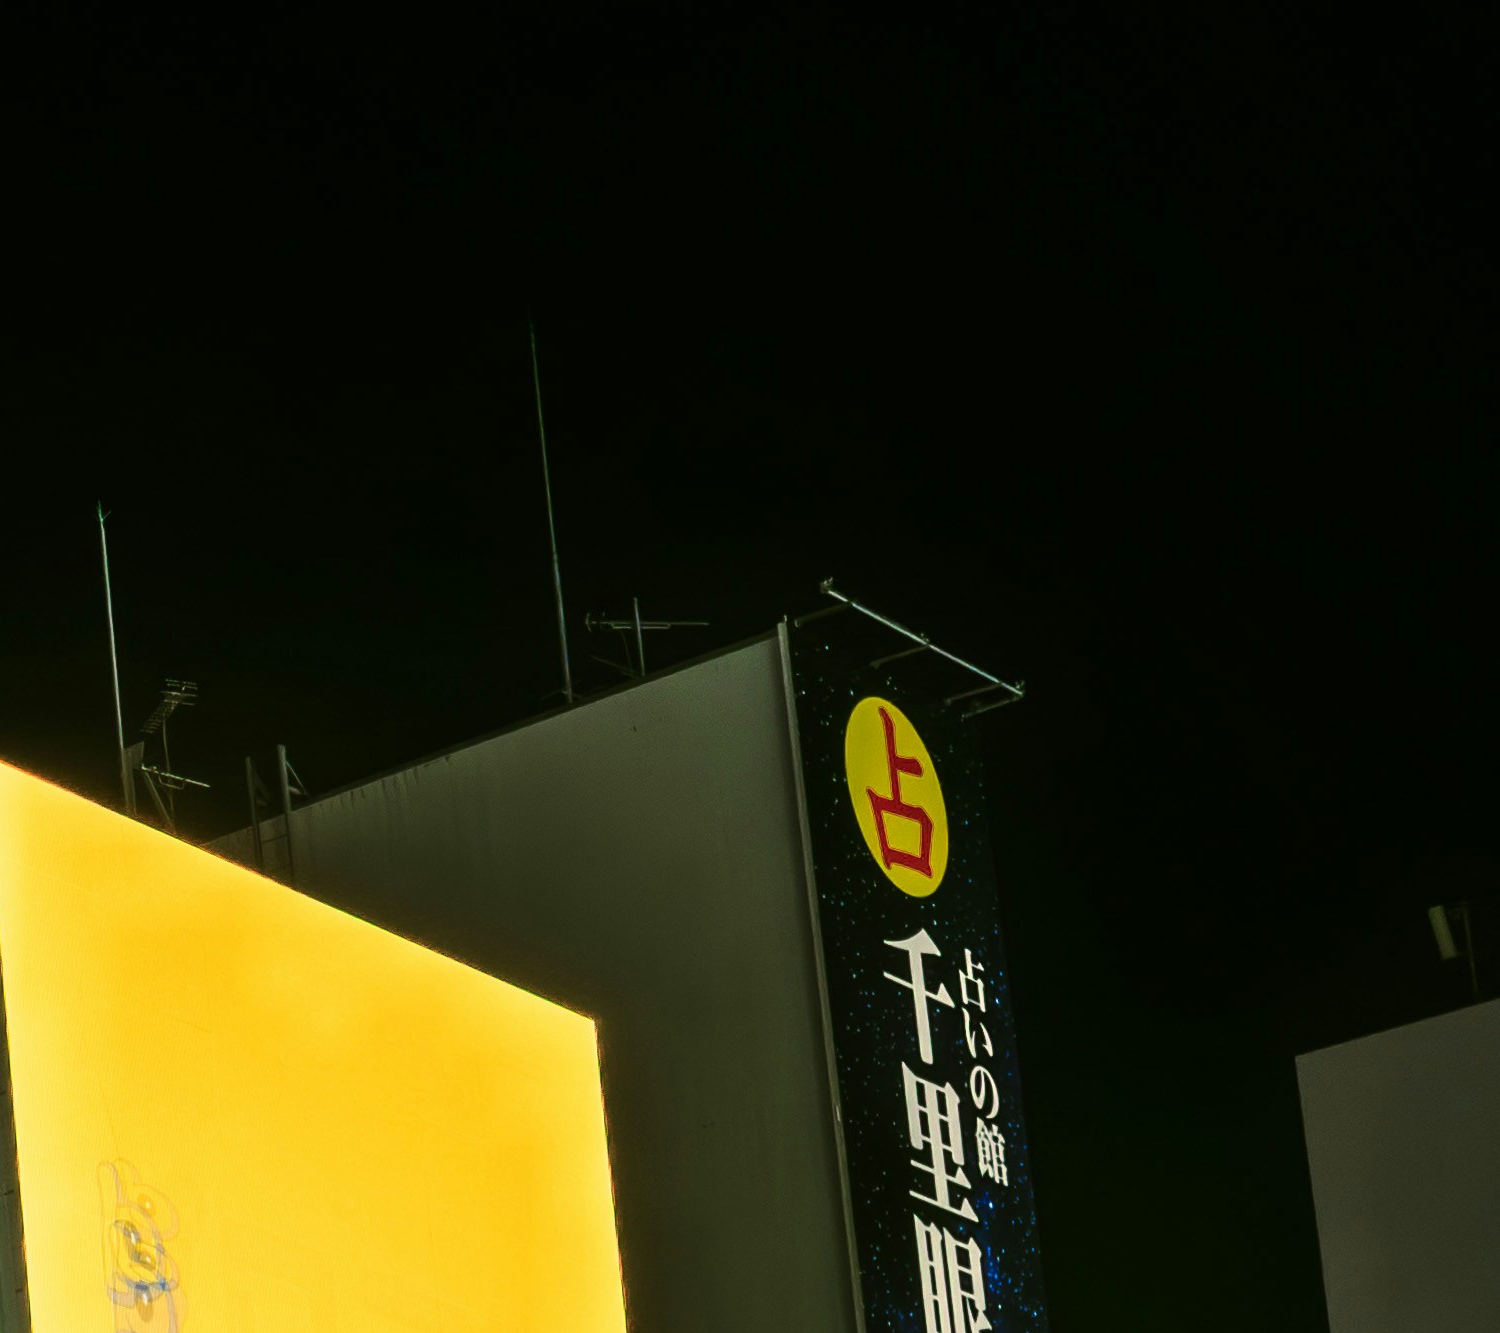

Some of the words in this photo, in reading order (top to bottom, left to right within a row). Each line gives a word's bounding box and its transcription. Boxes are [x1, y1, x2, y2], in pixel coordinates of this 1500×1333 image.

[866, 704, 934, 879] 占
[958, 948, 1010, 1188] 占いの館
